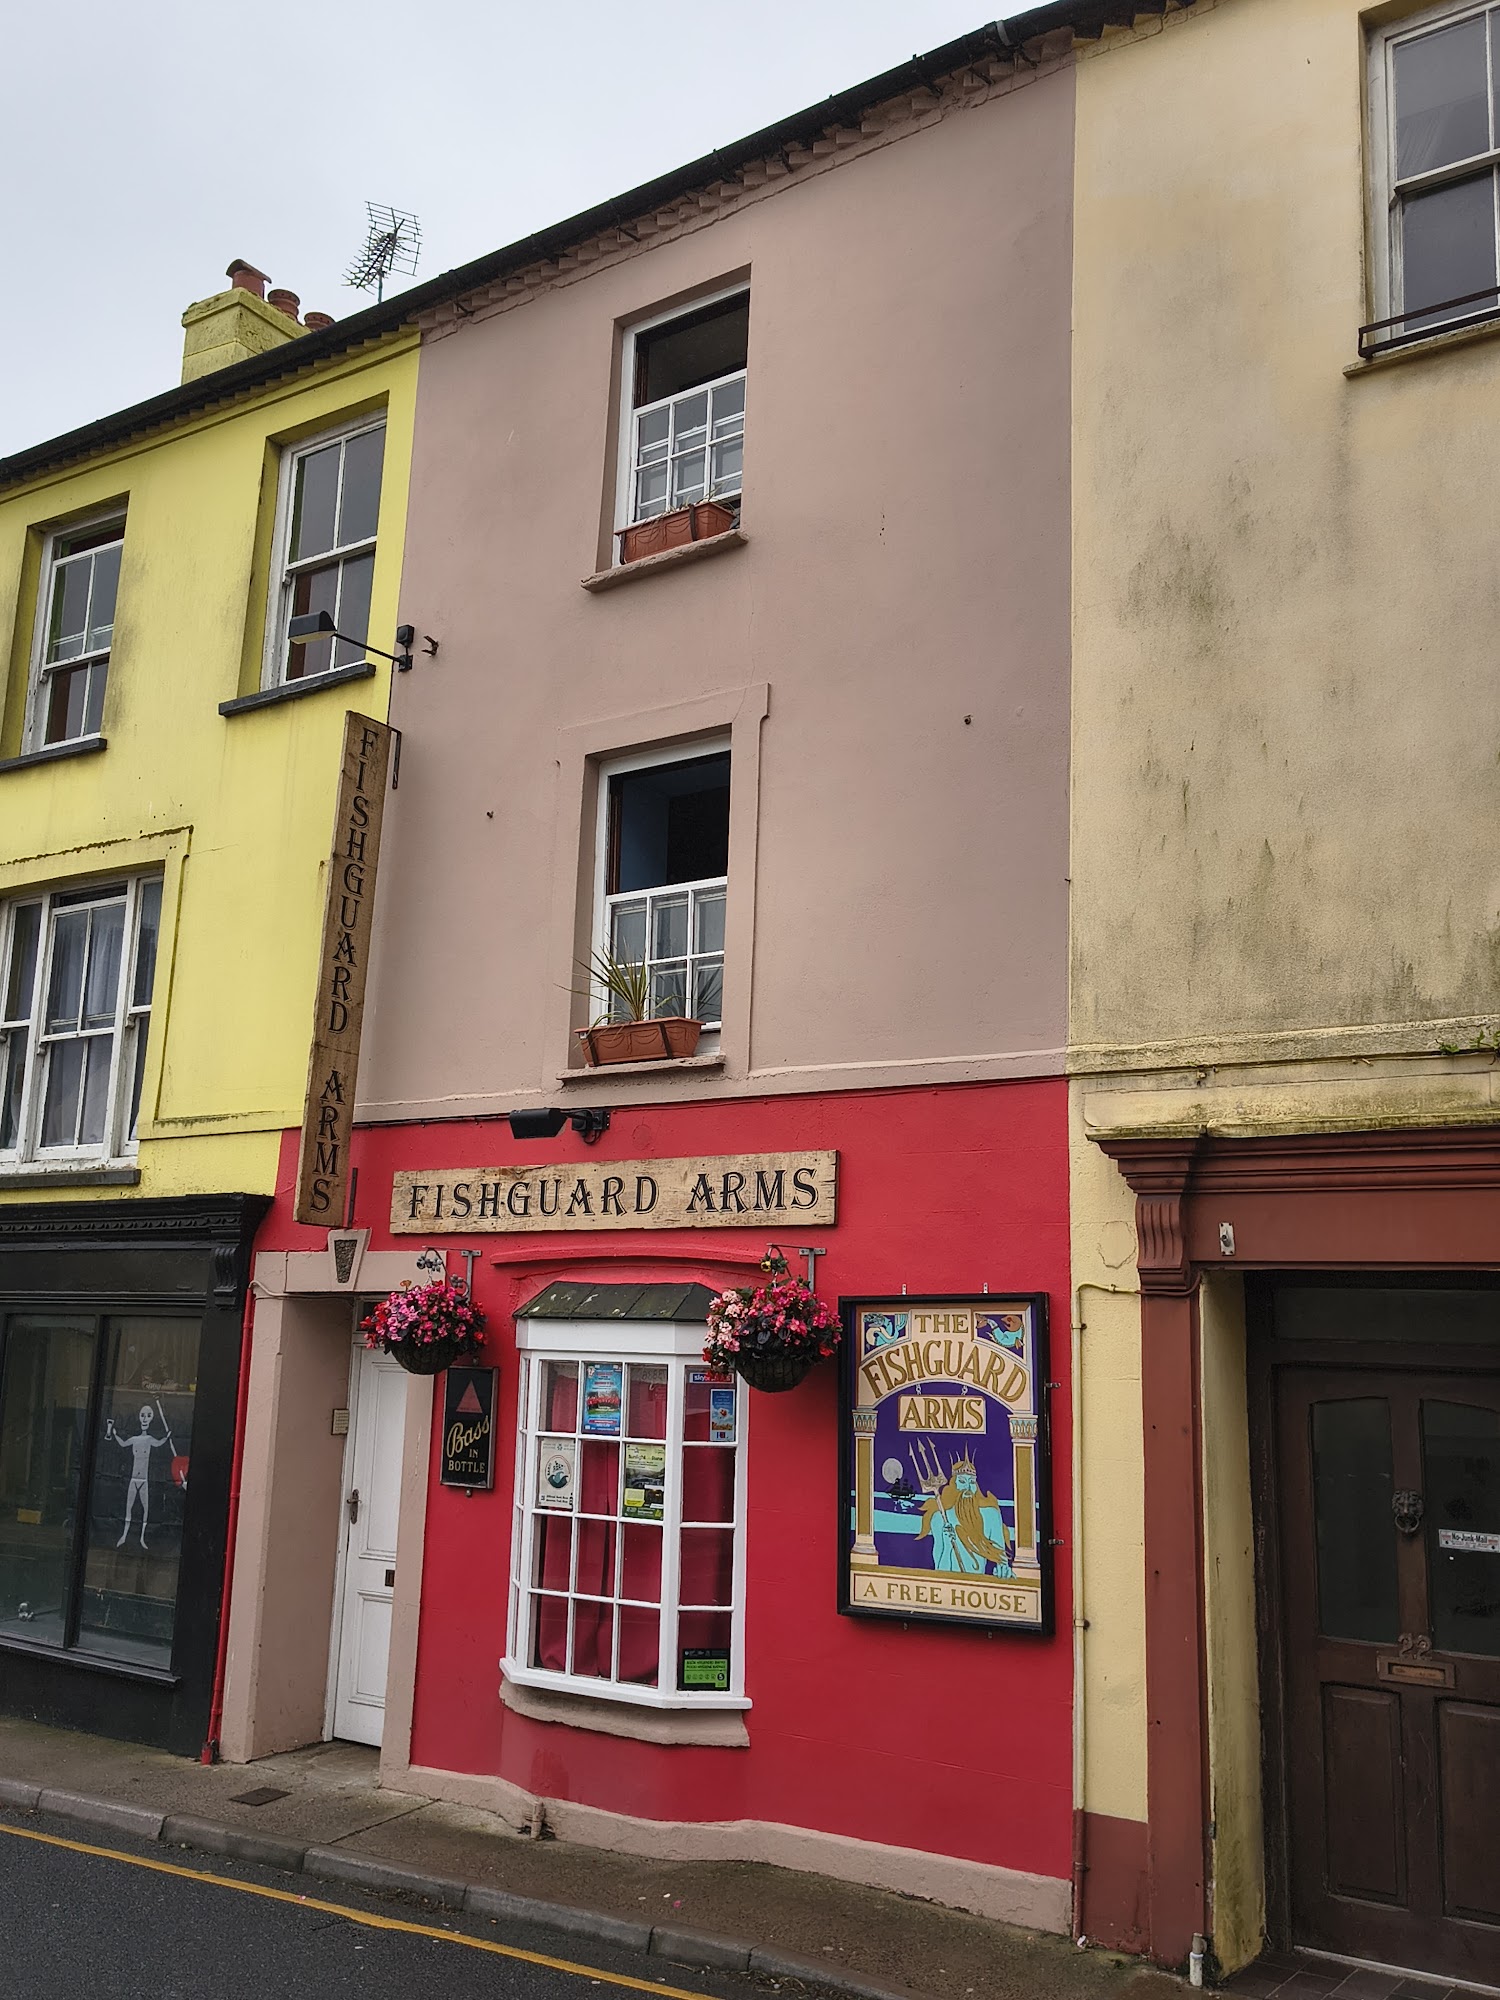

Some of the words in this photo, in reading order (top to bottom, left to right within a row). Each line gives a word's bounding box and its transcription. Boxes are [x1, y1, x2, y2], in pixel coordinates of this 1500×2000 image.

[328, 727, 379, 1034] FISHGUARD
[310, 1069, 345, 1213] ARMS
[407, 1175, 660, 1220] FISHGUARD
[685, 1167, 819, 1214] ARMS
[915, 1314, 969, 1334] THE
[862, 1340, 1028, 1403] FISHGUARD
[900, 1398, 984, 1430] ARMS
[447, 1415, 490, 1458] Bass
[448, 1460, 486, 1474] BOTTLE
[469, 1449, 479, 1459] IN
[863, 1582, 878, 1597] A
[887, 1583, 943, 1604] FREE
[951, 1588, 1027, 1613] HOUSE
[1398, 1633, 1432, 1660] 22
